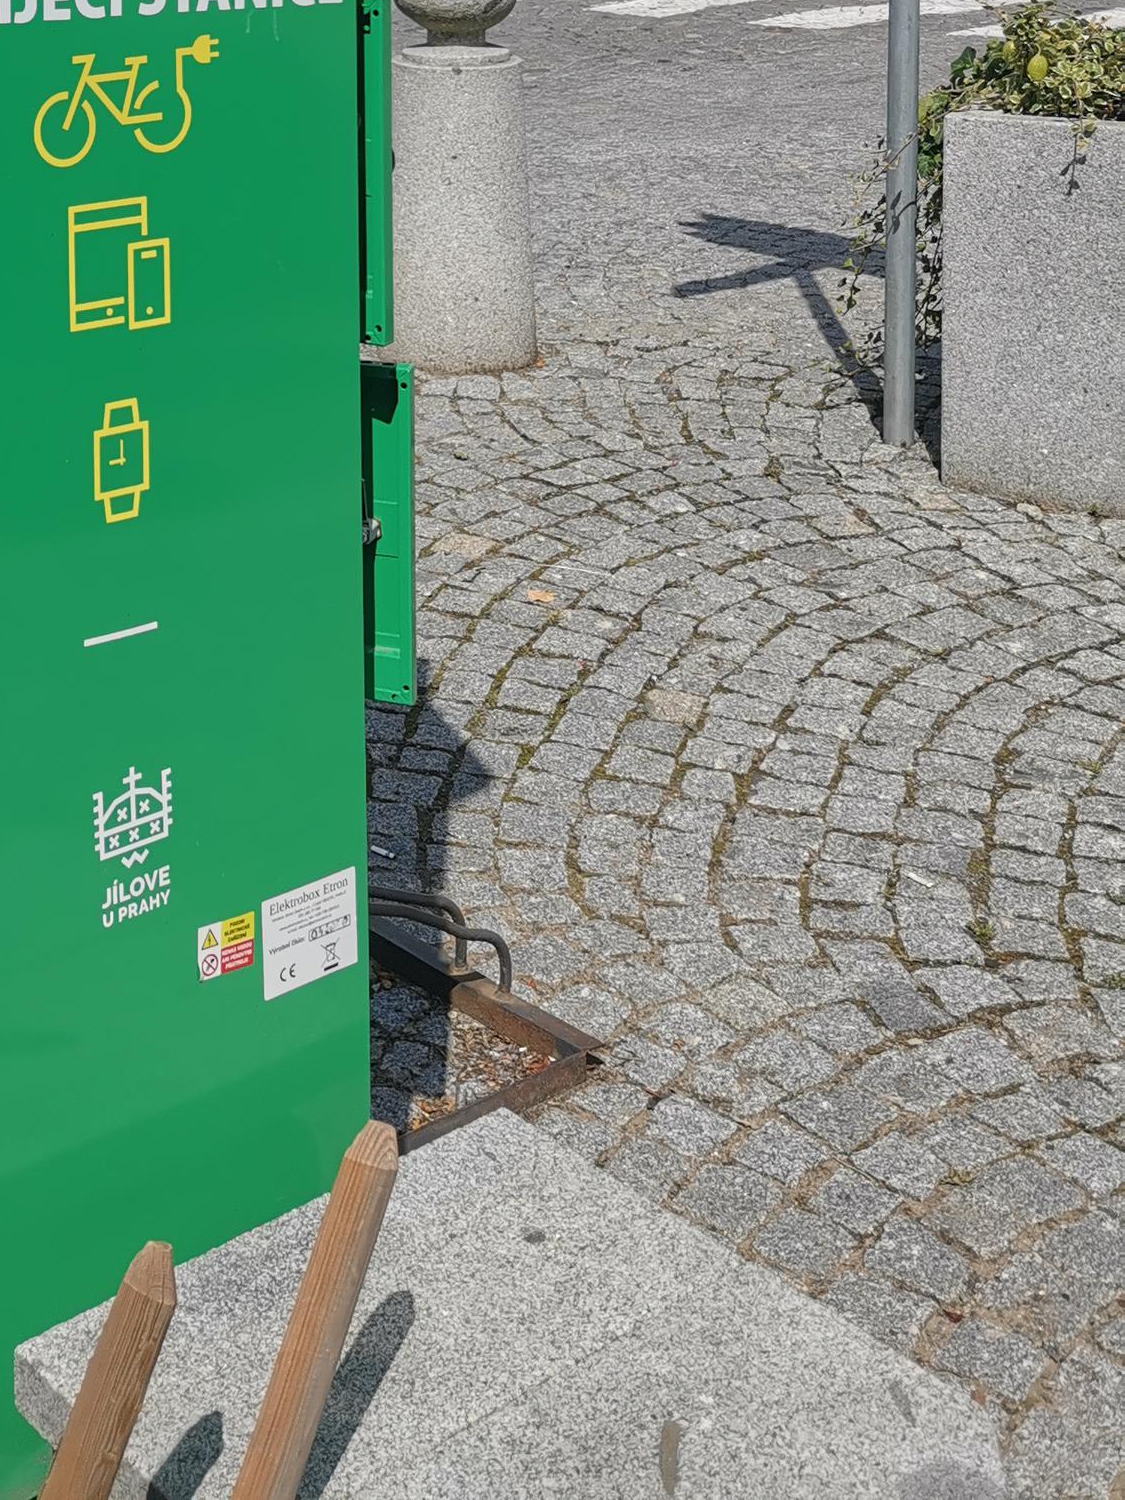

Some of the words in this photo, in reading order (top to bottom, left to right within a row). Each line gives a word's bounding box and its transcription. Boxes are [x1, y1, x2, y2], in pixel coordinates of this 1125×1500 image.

[102, 911, 114, 928] U
[118, 888, 171, 923] PRAHY
[269, 888, 320, 916] Elektrobox
[323, 877, 348, 895] Etron
[280, 964, 296, 981] CE
